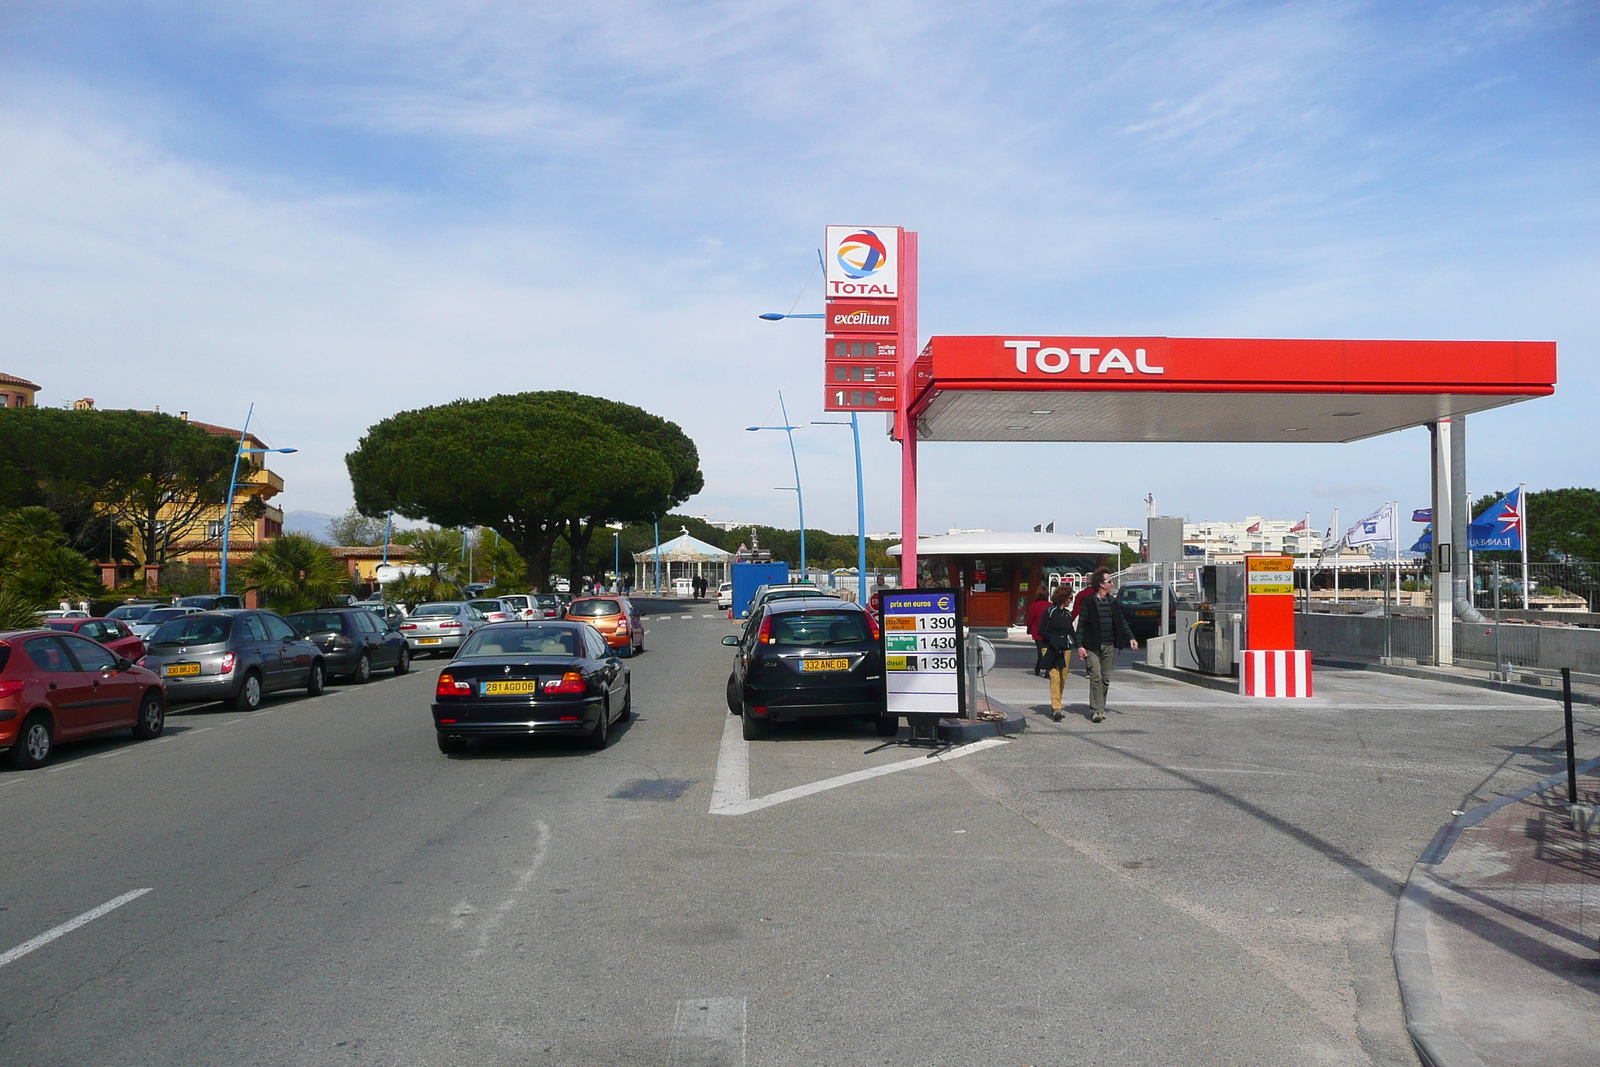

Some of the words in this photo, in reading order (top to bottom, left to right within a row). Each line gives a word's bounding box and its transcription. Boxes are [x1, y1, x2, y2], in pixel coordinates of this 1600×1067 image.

[834, 312, 890, 325] excellium
[890, 600, 902, 608] prix
[804, 660, 819, 669] 332
[820, 660, 835, 669] ANE
[837, 660, 847, 668] 06
[486, 683, 502, 691] 281
[504, 683, 521, 691] AGD
[522, 682, 533, 690] 06
